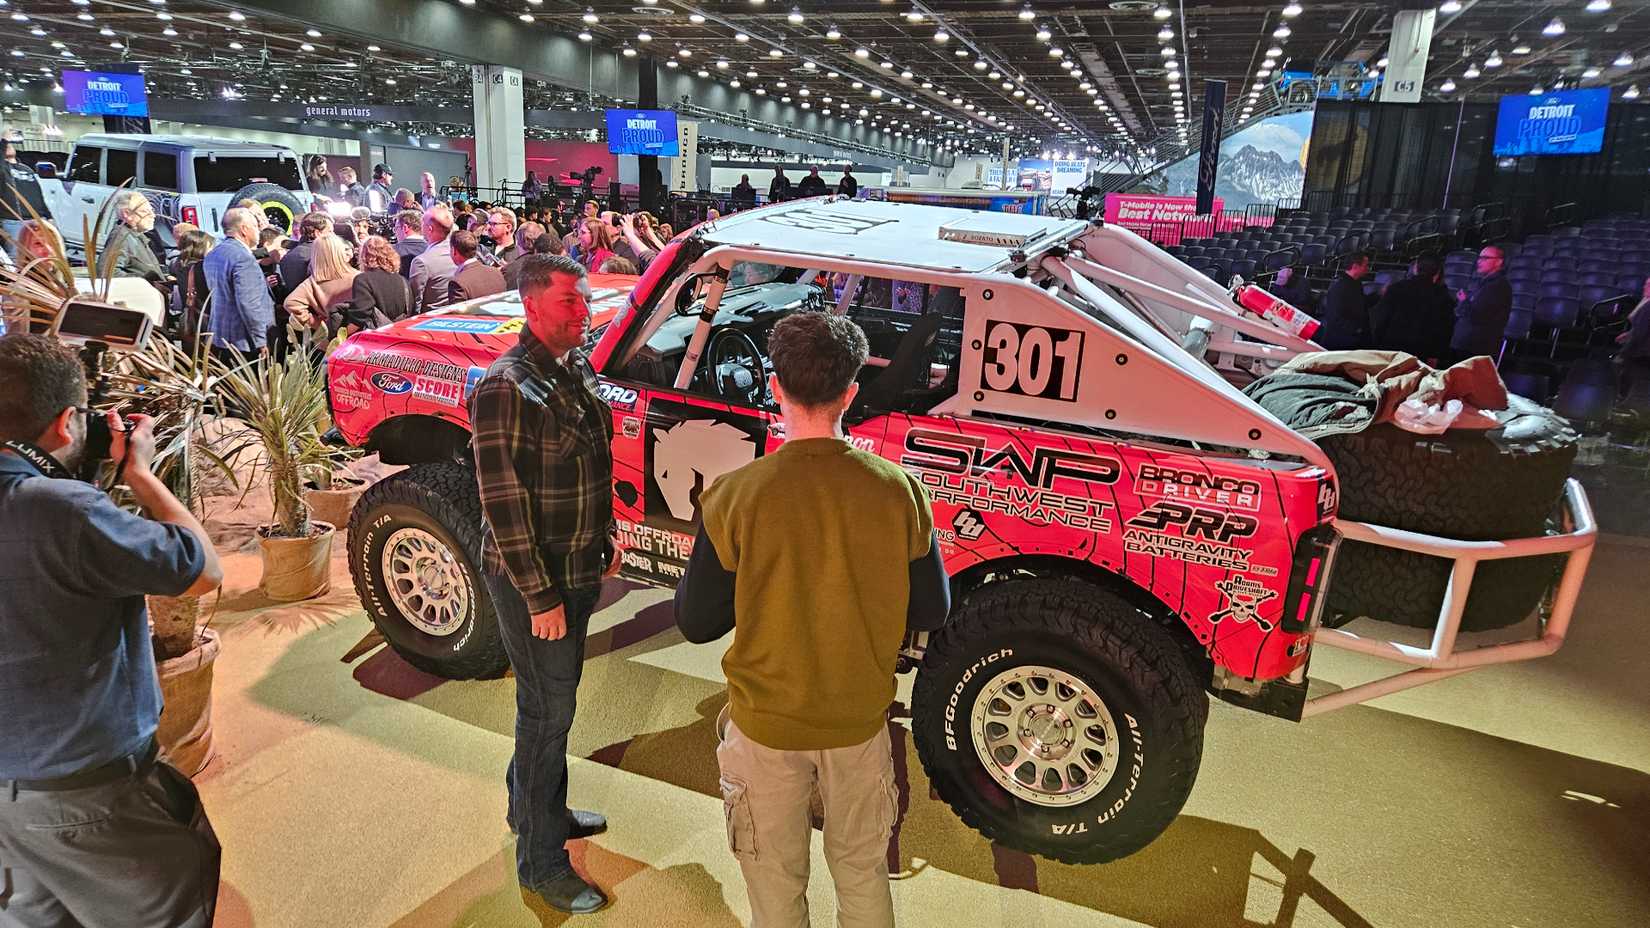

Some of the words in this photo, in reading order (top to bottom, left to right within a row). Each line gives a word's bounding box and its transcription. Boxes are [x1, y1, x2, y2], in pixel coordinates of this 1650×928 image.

[83, 89, 129, 104] PROUD
[88, 81, 121, 91] DETROIT
[306, 106, 338, 117] general
[341, 107, 371, 117] motors
[1529, 104, 1576, 120] DETROIT
[627, 119, 657, 130] DETROIT
[1519, 115, 1581, 138] PROUD
[622, 128, 665, 145] PROUD
[680, 127, 689, 189] BRONCO
[1118, 208, 1151, 220] Best
[1119, 201, 1155, 209] T-Mobile
[1164, 203, 1184, 211] Now
[427, 320, 496, 331] BILSTEIN
[365, 351, 422, 375] ARMADILLO
[423, 359, 466, 382] DESIGNS
[984, 322, 1082, 400] 301
[378, 373, 406, 391] Ford
[417, 378, 458, 399] SCORE
[599, 384, 638, 403] ORD
[5, 440, 56, 474] LUMIX
[901, 427, 1122, 492] SWP
[1138, 464, 1262, 495] BRONCO
[914, 472, 1115, 517] OUTHWEST
[1141, 480, 1255, 507] DRIVER
[373, 514, 392, 529] T/A
[928, 488, 1113, 534] RFORMANCE
[1125, 501, 1260, 545] PRP
[655, 539, 691, 560] THE
[1123, 529, 1253, 561] ANTIGRAVITY
[1126, 541, 1250, 571] BATTERIES
[363, 532, 388, 617] All-Terrain
[944, 648, 1014, 751] BFGoodrich
[1097, 712, 1145, 824] All-Terrain
[1051, 821, 1089, 836] T/A
